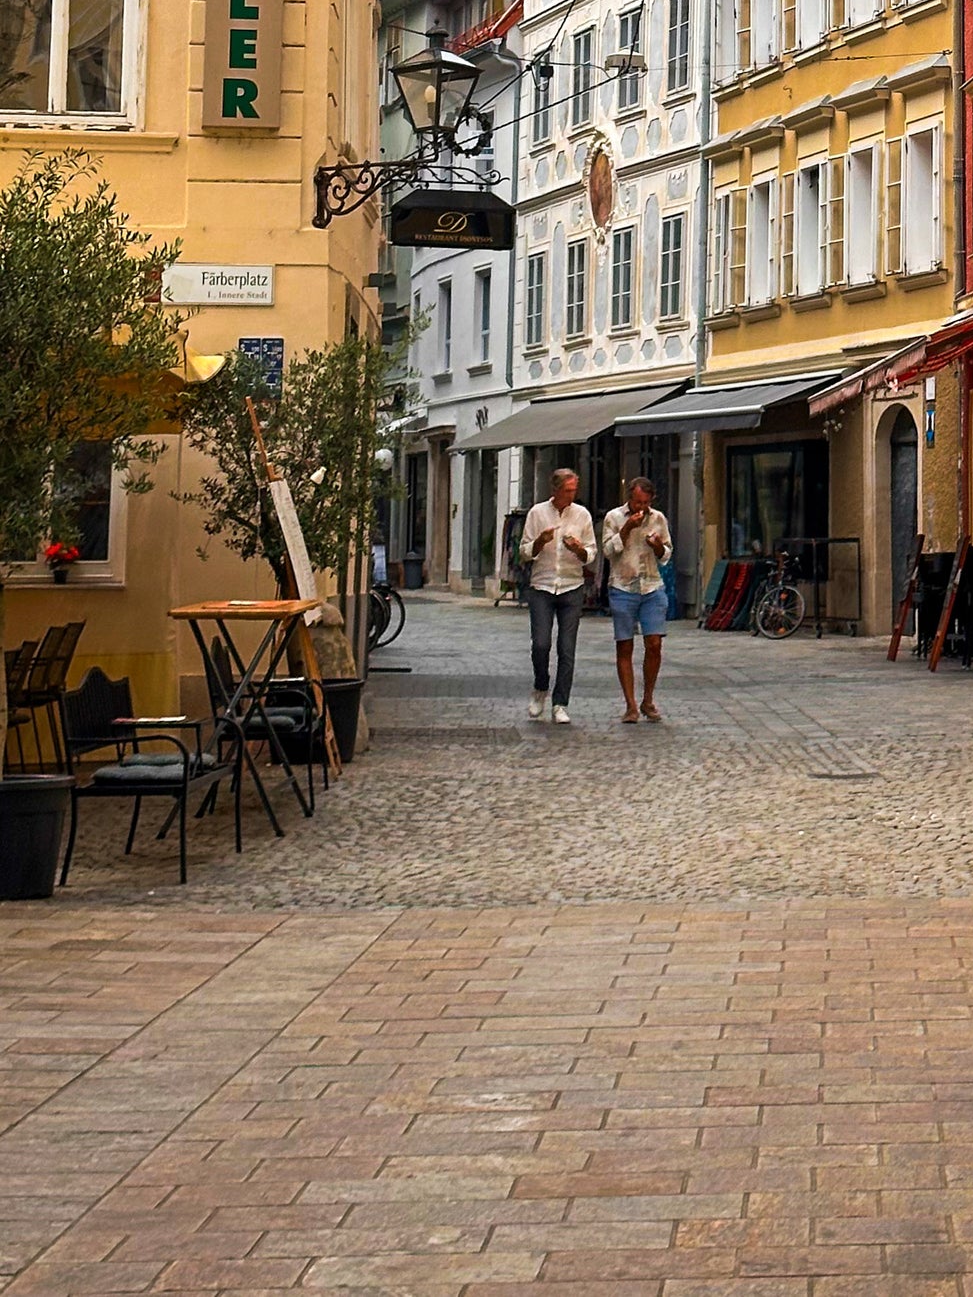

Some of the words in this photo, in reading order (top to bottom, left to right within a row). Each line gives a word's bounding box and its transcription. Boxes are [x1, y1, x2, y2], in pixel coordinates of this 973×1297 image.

[202, 271, 268, 290] Färberplatz
[219, 290, 244, 299] Innere
[247, 290, 268, 299] Stadt
